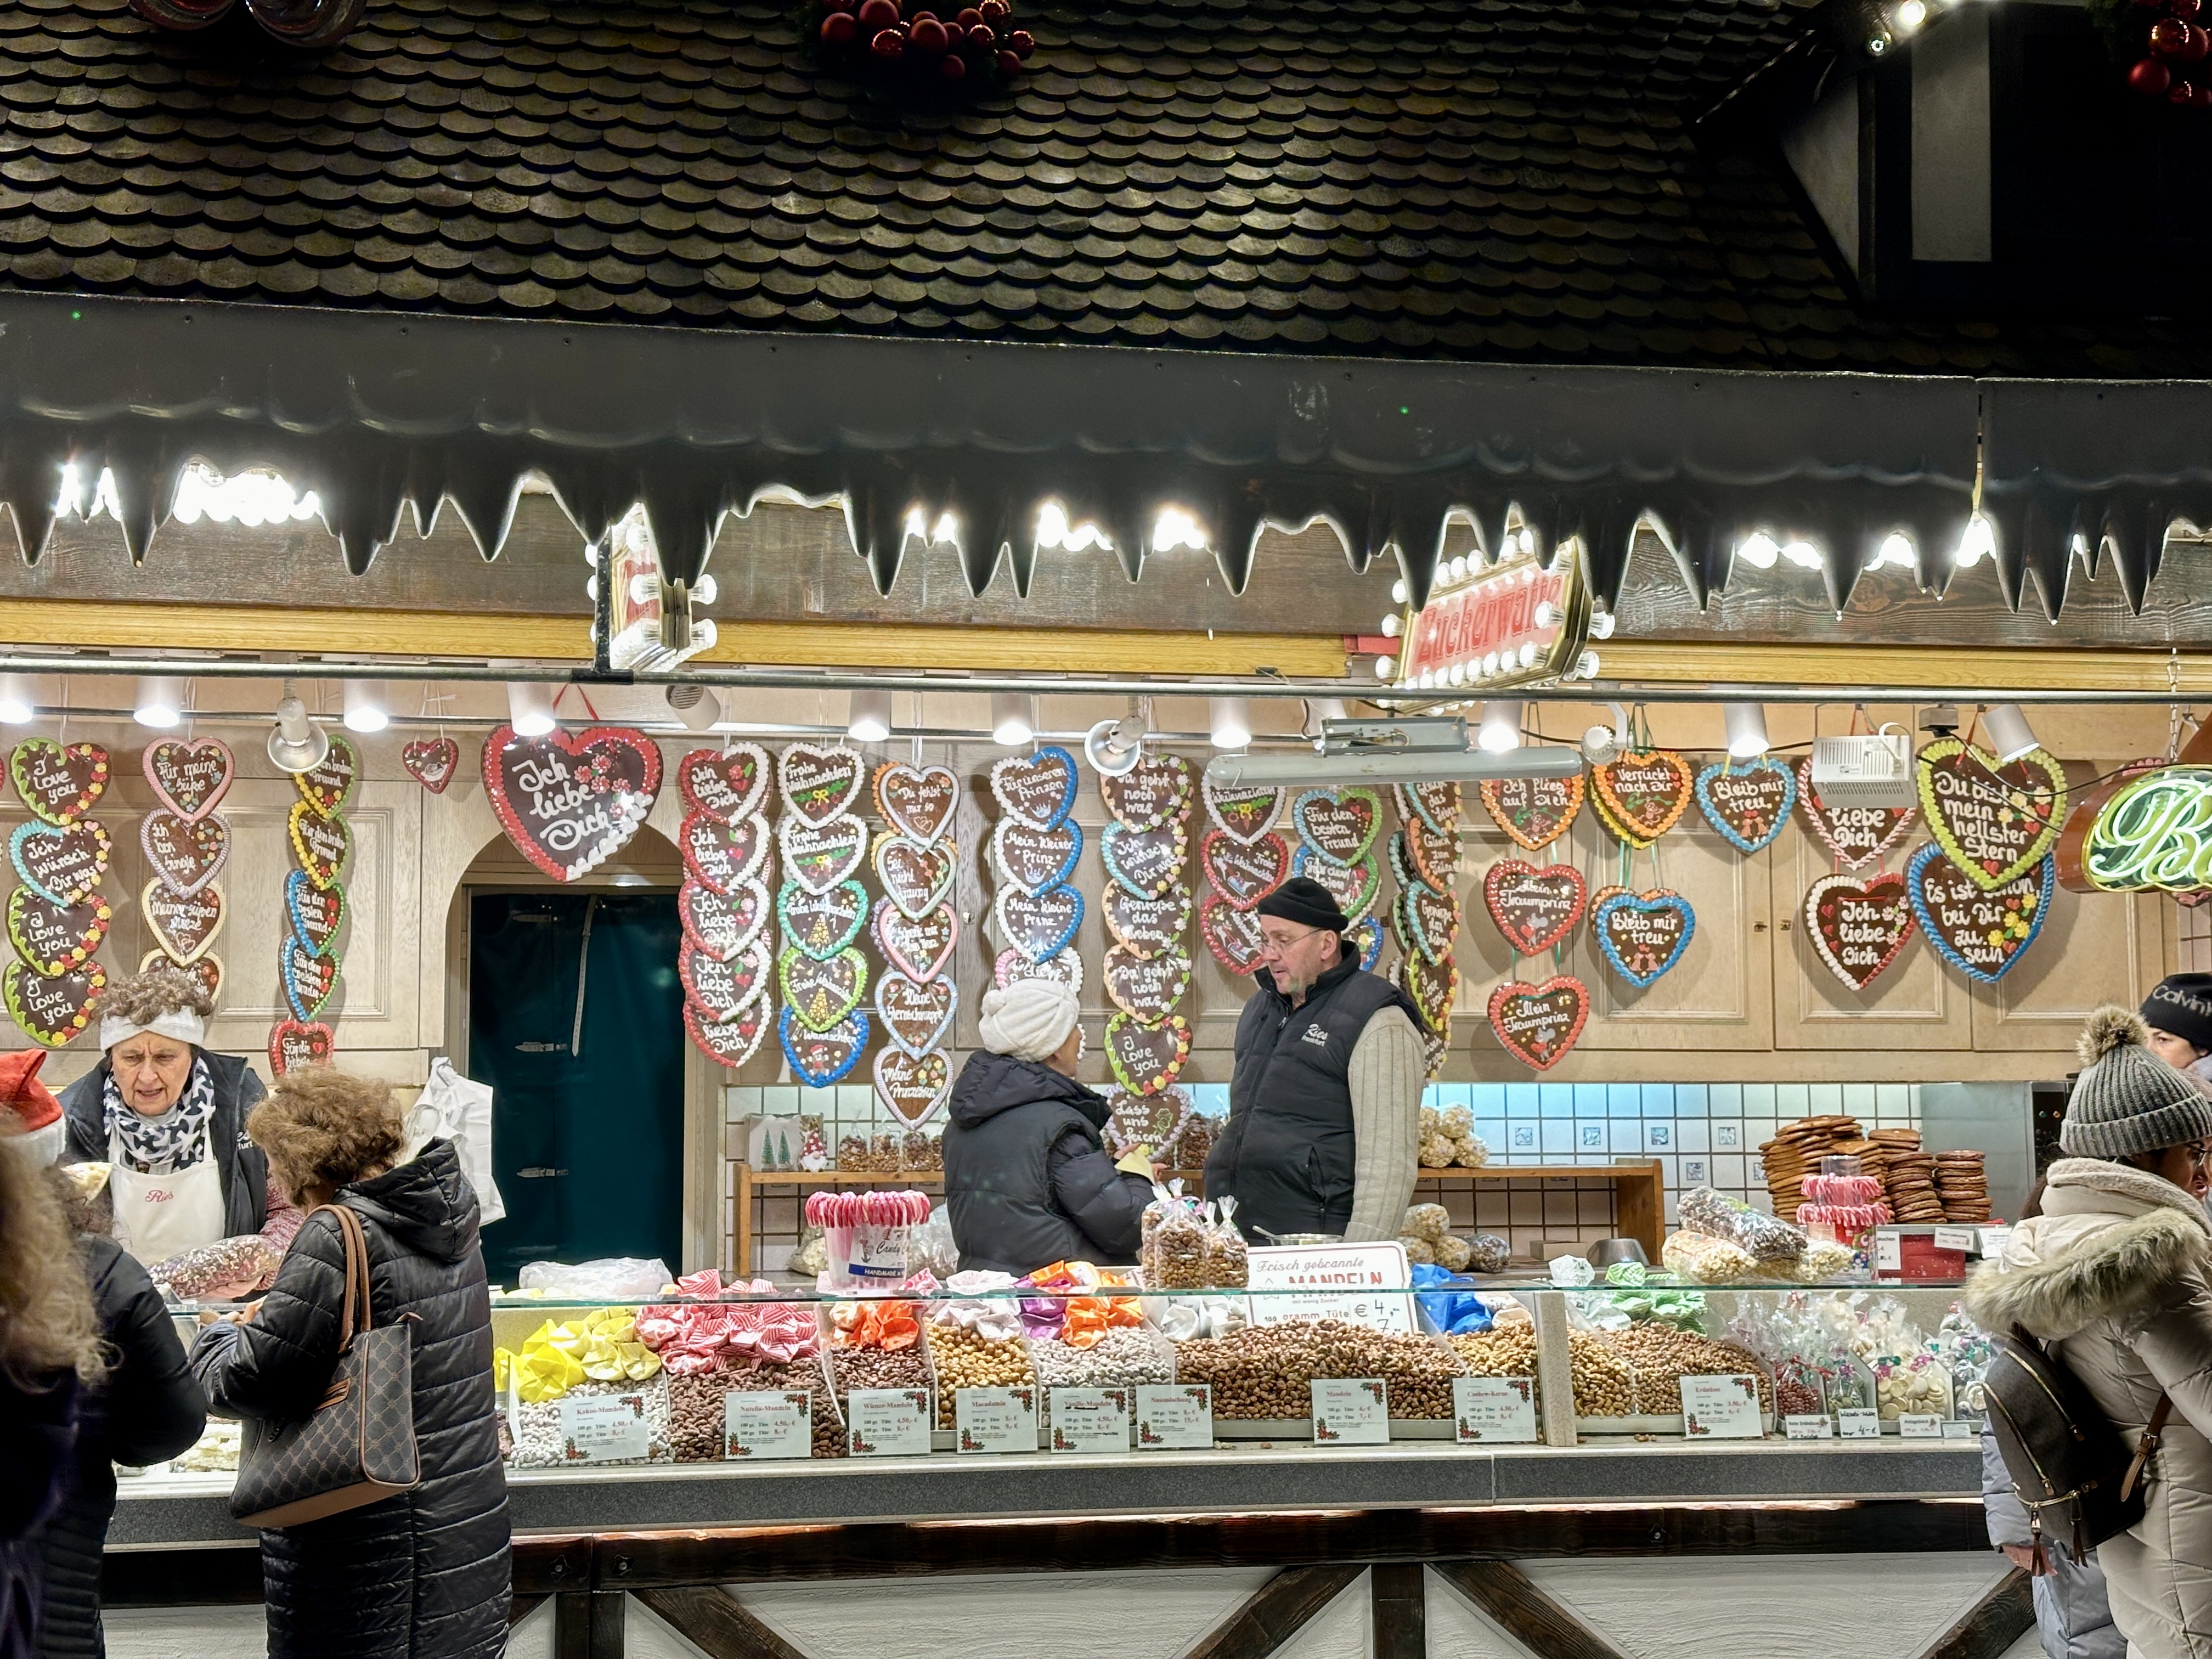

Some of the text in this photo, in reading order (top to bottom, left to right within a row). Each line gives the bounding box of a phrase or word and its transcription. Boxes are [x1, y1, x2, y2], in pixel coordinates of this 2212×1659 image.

[156, 757, 217, 780] Für meine
[511, 753, 571, 792] Ich
[691, 765, 718, 783] Ich
[1616, 767, 1671, 781] Verrückt
[692, 779, 728, 798] liebe
[1139, 771, 1171, 790] geht
[1503, 778, 1527, 794] Ich
[1615, 781, 1673, 793] nach Dir
[1714, 780, 1785, 800] Bleib mir
[1934, 771, 2010, 805] Du bist
[47, 783, 79, 805] you
[529, 781, 595, 820] liebe
[706, 788, 742, 809] Dich
[898, 783, 941, 803] Du fehlst
[1018, 780, 1065, 802] Prinzen
[1124, 786, 1156, 802] noch
[1125, 802, 1154, 814] was
[1503, 793, 1570, 809] auf Dich
[1729, 797, 1769, 813] treu
[1943, 798, 1994, 822] mein
[1305, 806, 1356, 823] Für den
[1826, 808, 1886, 828] liebe
[152, 823, 170, 838] Ich
[539, 802, 611, 851] Dich
[1311, 822, 1351, 836] besten
[1952, 815, 2028, 845] hellster
[154, 837, 176, 854] bin
[690, 827, 719, 847] Ich
[1005, 832, 1038, 847] Mein
[1117, 837, 1144, 855] Ich
[1318, 833, 1361, 850] Freund
[1833, 826, 1878, 848] Dich
[26, 840, 61, 859] Ich
[695, 845, 729, 864] liebe
[1022, 850, 1057, 865] Prinz
[1965, 838, 2018, 864] Stern
[703, 859, 734, 876] Dich
[886, 854, 903, 872] Sei
[1134, 856, 1179, 885] Dir was
[49, 865, 98, 892] Dir was
[891, 871, 916, 886] nicht
[1925, 878, 1978, 904] Es ist
[692, 894, 727, 913] Ich
[1007, 898, 1039, 912] Mein
[1499, 890, 1572, 914] Traumprinz
[1841, 900, 1881, 922] Ich
[698, 911, 737, 929] liebe
[1023, 913, 1058, 926] Prinz
[1132, 911, 1158, 925] das
[1611, 911, 1678, 931] Bleib mir
[1941, 902, 2005, 927] bei Dir
[702, 924, 741, 945] Dich
[1630, 929, 1666, 944] treu
[1839, 923, 1886, 943] liebe
[38, 936, 75, 958] you
[1841, 945, 1881, 966] Dich
[1962, 947, 2005, 964] sein
[695, 956, 732, 975] Ich
[696, 974, 735, 994] liebe
[1131, 980, 1163, 994] noch
[701, 990, 736, 1010] Dich
[1133, 994, 1163, 1008] was
[1429, 990, 1444, 1012] you
[1516, 1000, 1550, 1018] Mein
[2153, 985, 2205, 1014] Calvin
[42, 1002, 76, 1026] you
[1503, 1012, 1570, 1033] Traumprinz
[702, 1021, 741, 1040] liebe
[1305, 1023, 1328, 1040] Ries
[710, 1036, 748, 1055] Dich
[1133, 1057, 1161, 1077] you
[1115, 1101, 1150, 1116] Lass
[1122, 1116, 1149, 1127] uns
[145, 1189, 174, 1203] Ries
[876, 1241, 901, 1255] Candy
[865, 1269, 898, 1277] HANDMADE
[1256, 1257, 1364, 1273] Frisch gebrannte
[1325, 1309, 1350, 1318] Tüte
[1353, 1304, 1368, 1317] €
